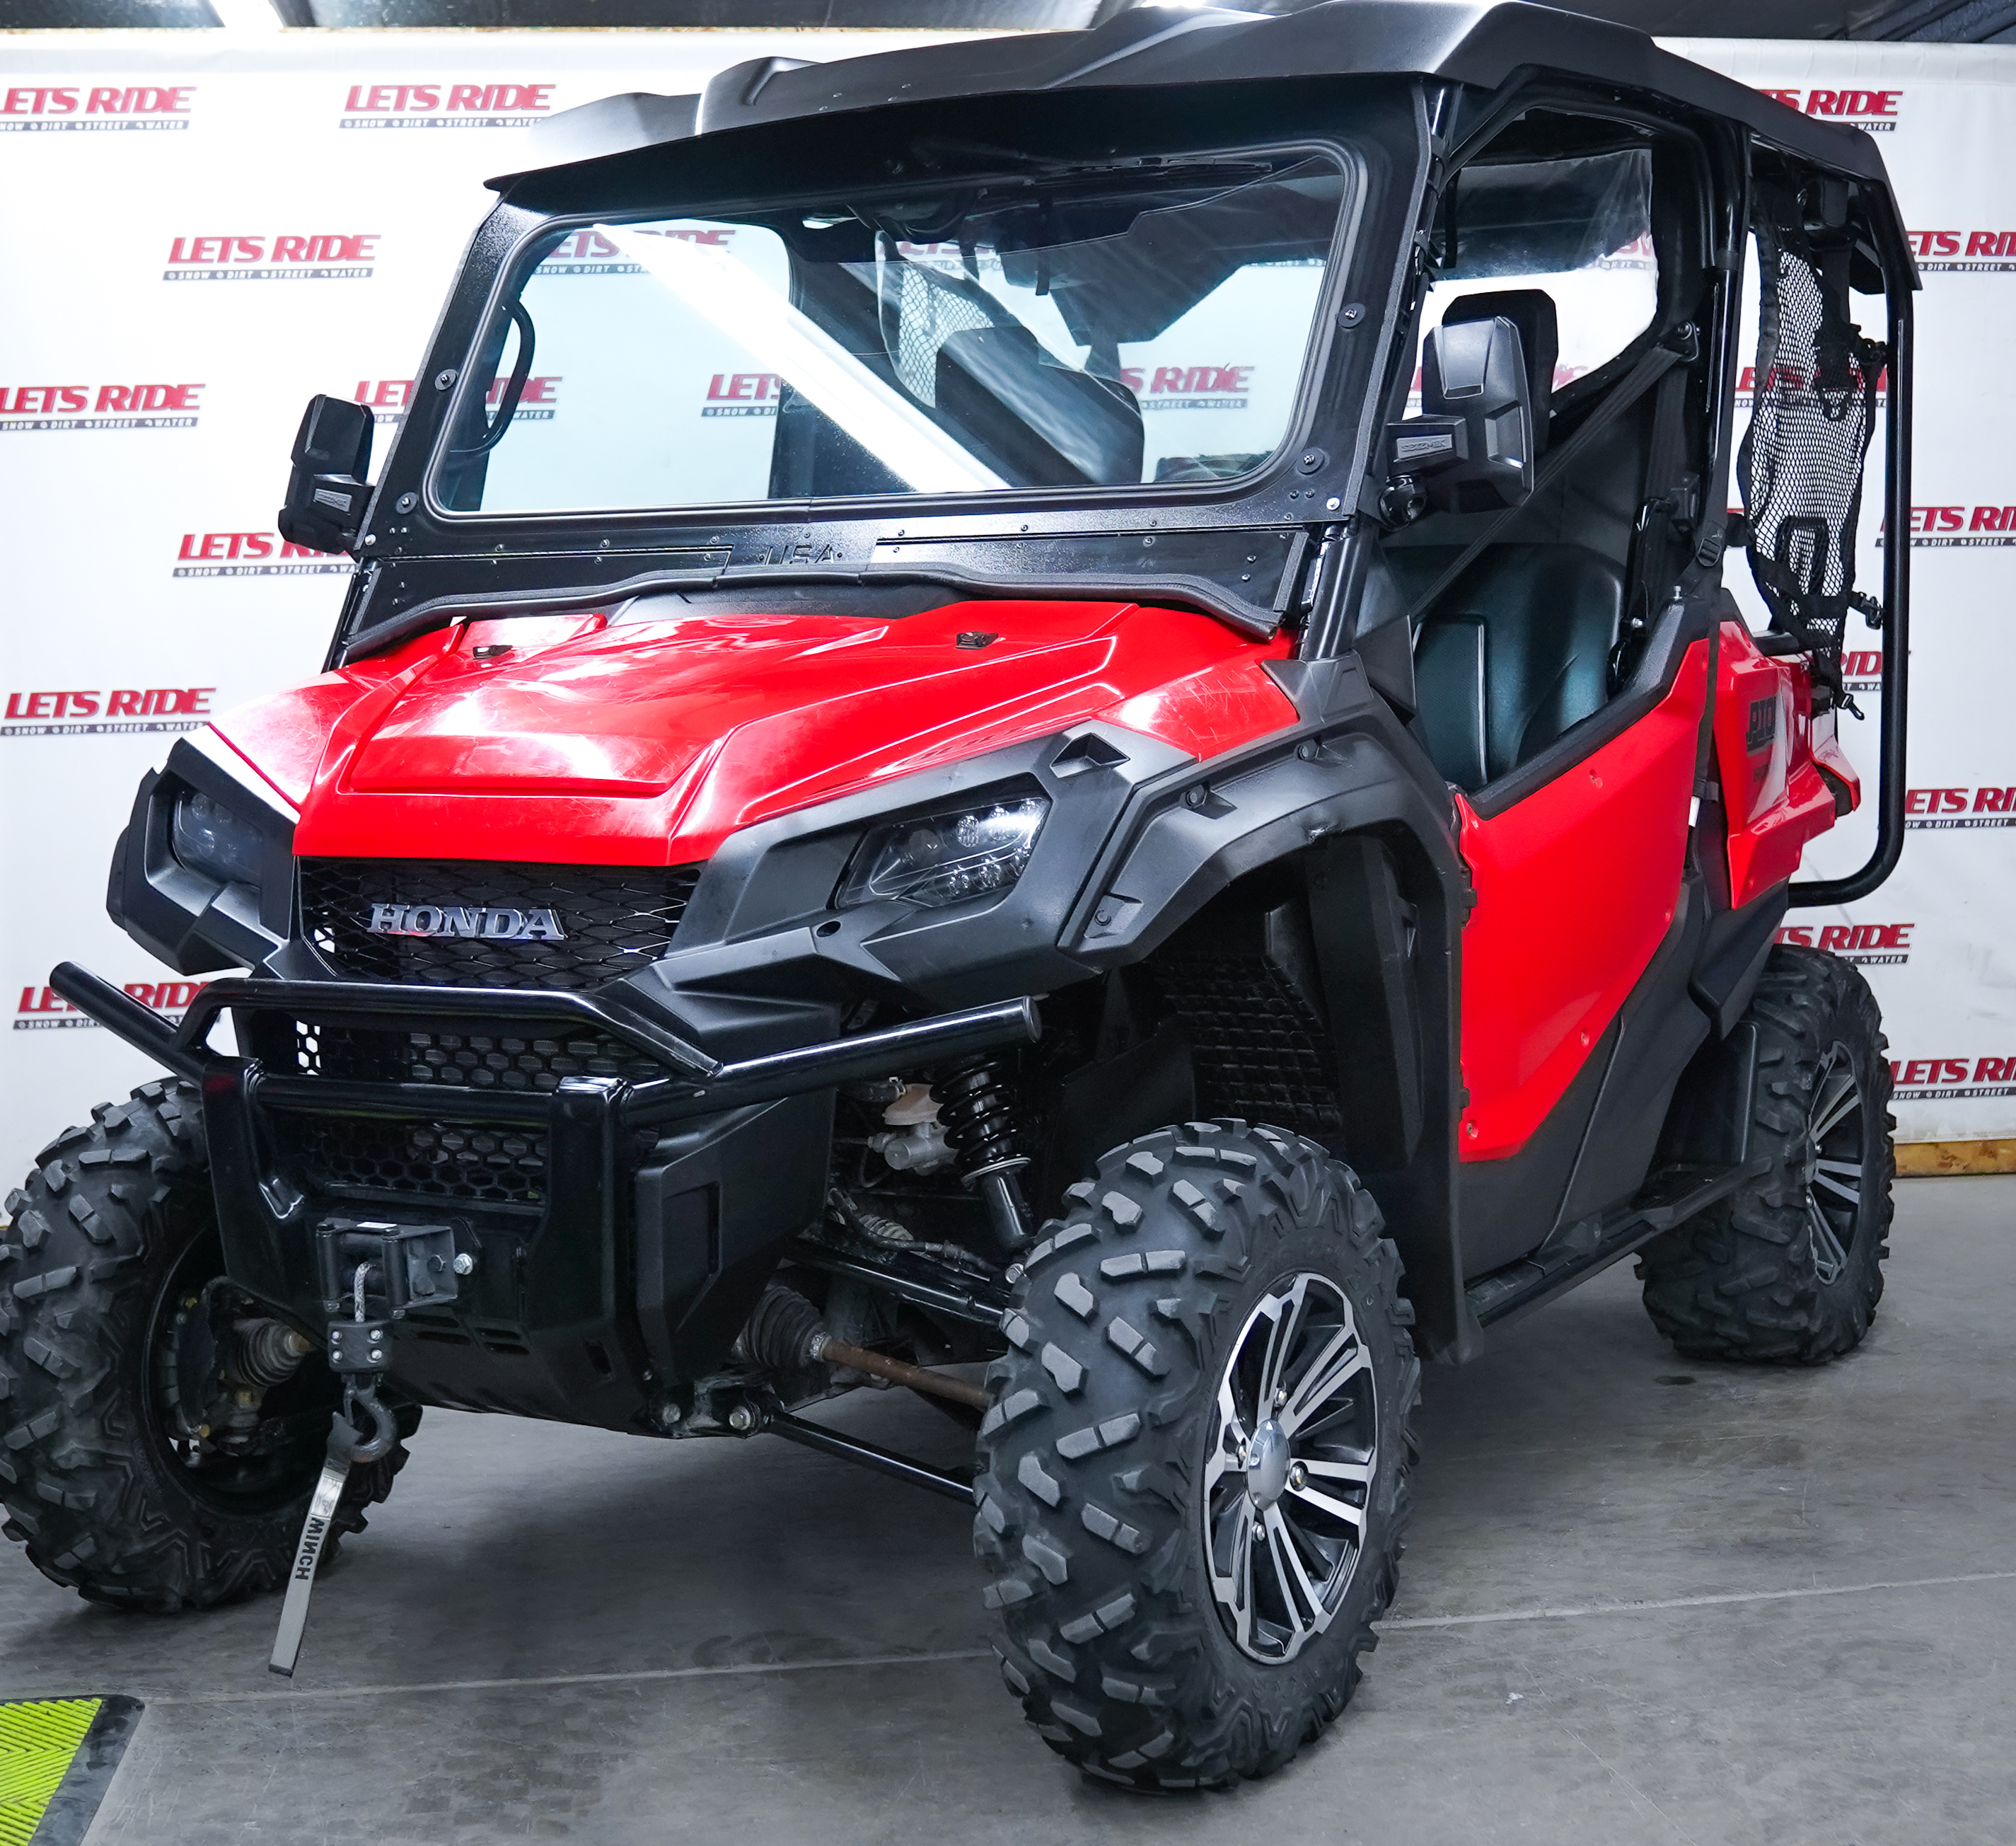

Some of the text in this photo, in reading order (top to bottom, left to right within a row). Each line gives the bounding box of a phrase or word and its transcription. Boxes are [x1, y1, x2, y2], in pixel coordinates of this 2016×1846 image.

[0, 86, 197, 114] ETS RIDE
[344, 84, 557, 112] LETS RIDE
[1806, 90, 1903, 115] RIDE
[39, 122, 68, 130] DIRT
[84, 121, 129, 130] STREET
[146, 121, 185, 129] WATER
[354, 119, 387, 128] SNOW
[402, 118, 429, 127] DIRT
[445, 118, 489, 127] STREET
[1858, 122, 1891, 131] WATER
[168, 234, 381, 264] LETS RIDE
[178, 268, 369, 279] SNOW DIRT STREET WATER
[583, 265, 610, 274] DIRT
[94, 383, 205, 412] RIDE
[707, 374, 780, 400] LET
[2, 418, 193, 431] SNOW DIRT STREET WATER
[1969, 506, 2016, 532] RI
[178, 532, 274, 560] LETS
[187, 565, 322, 577] SNOW DIRT STREET
[4, 688, 216, 720] LETS RIDE
[14, 727, 47, 736] SNOW
[62, 725, 90, 734] DIRT
[105, 724, 149, 733] STREET
[1972, 787, 2016, 813] RI
[1935, 819, 1959, 829] DIRT
[1972, 819, 2009, 828] STREET
[366, 902, 569, 941] HONDA
[1818, 923, 1915, 950] RIDE
[1870, 956, 1903, 964] WATER
[124, 981, 212, 1009] RID
[28, 1020, 60, 1029] SNOW
[1891, 1057, 2016, 1085] LETS RI
[1935, 1090, 1958, 1099] DIRT
[1972, 1088, 2009, 1097] STREET
